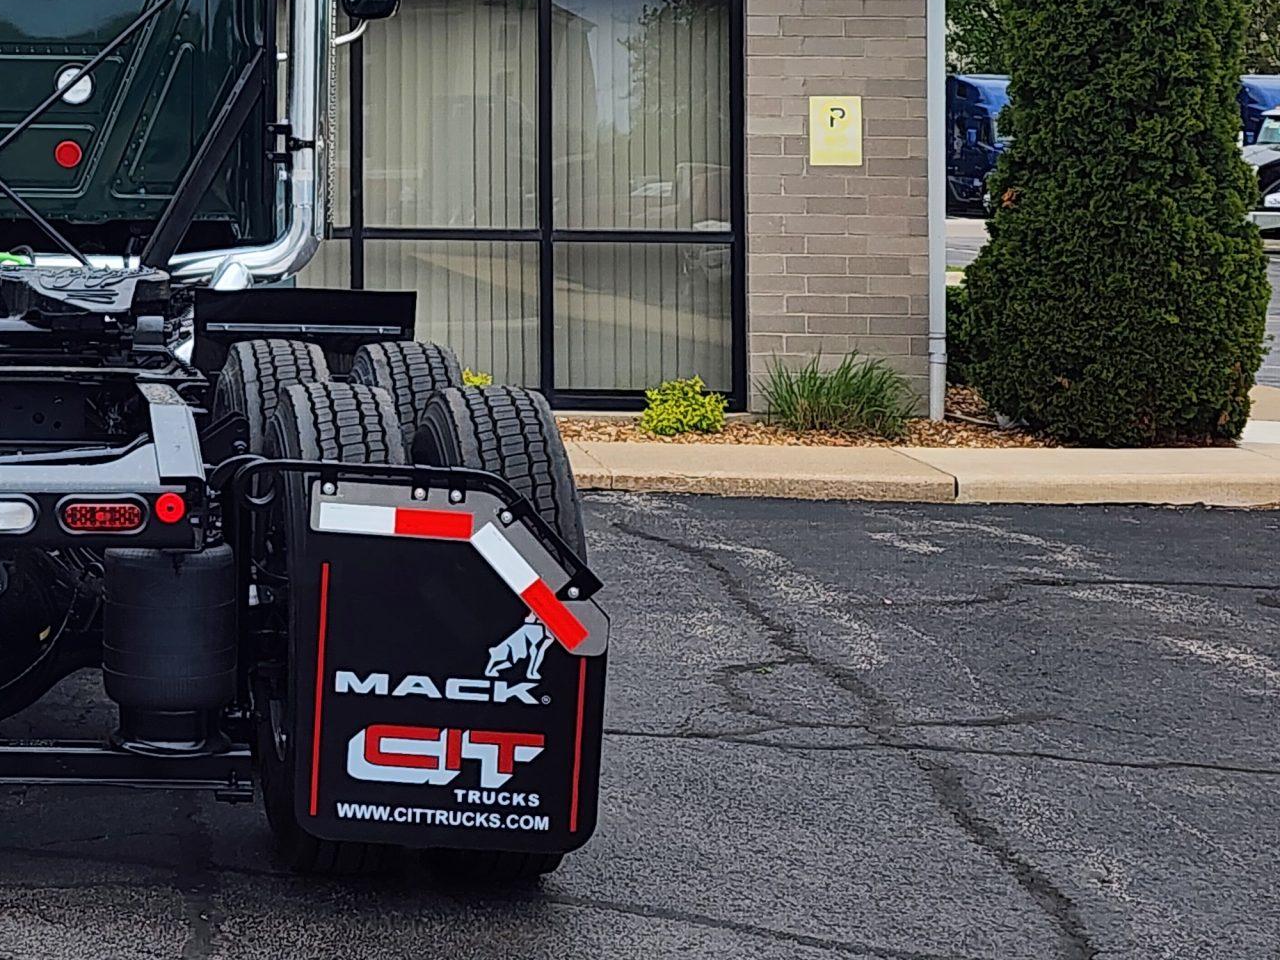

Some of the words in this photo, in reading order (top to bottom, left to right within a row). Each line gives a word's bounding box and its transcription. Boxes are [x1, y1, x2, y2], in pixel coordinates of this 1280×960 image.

[346, 724, 545, 789] CIT
[454, 789, 540, 807] TRUCKS
[336, 802, 550, 831] WWW.CITTRUCKS.COM
